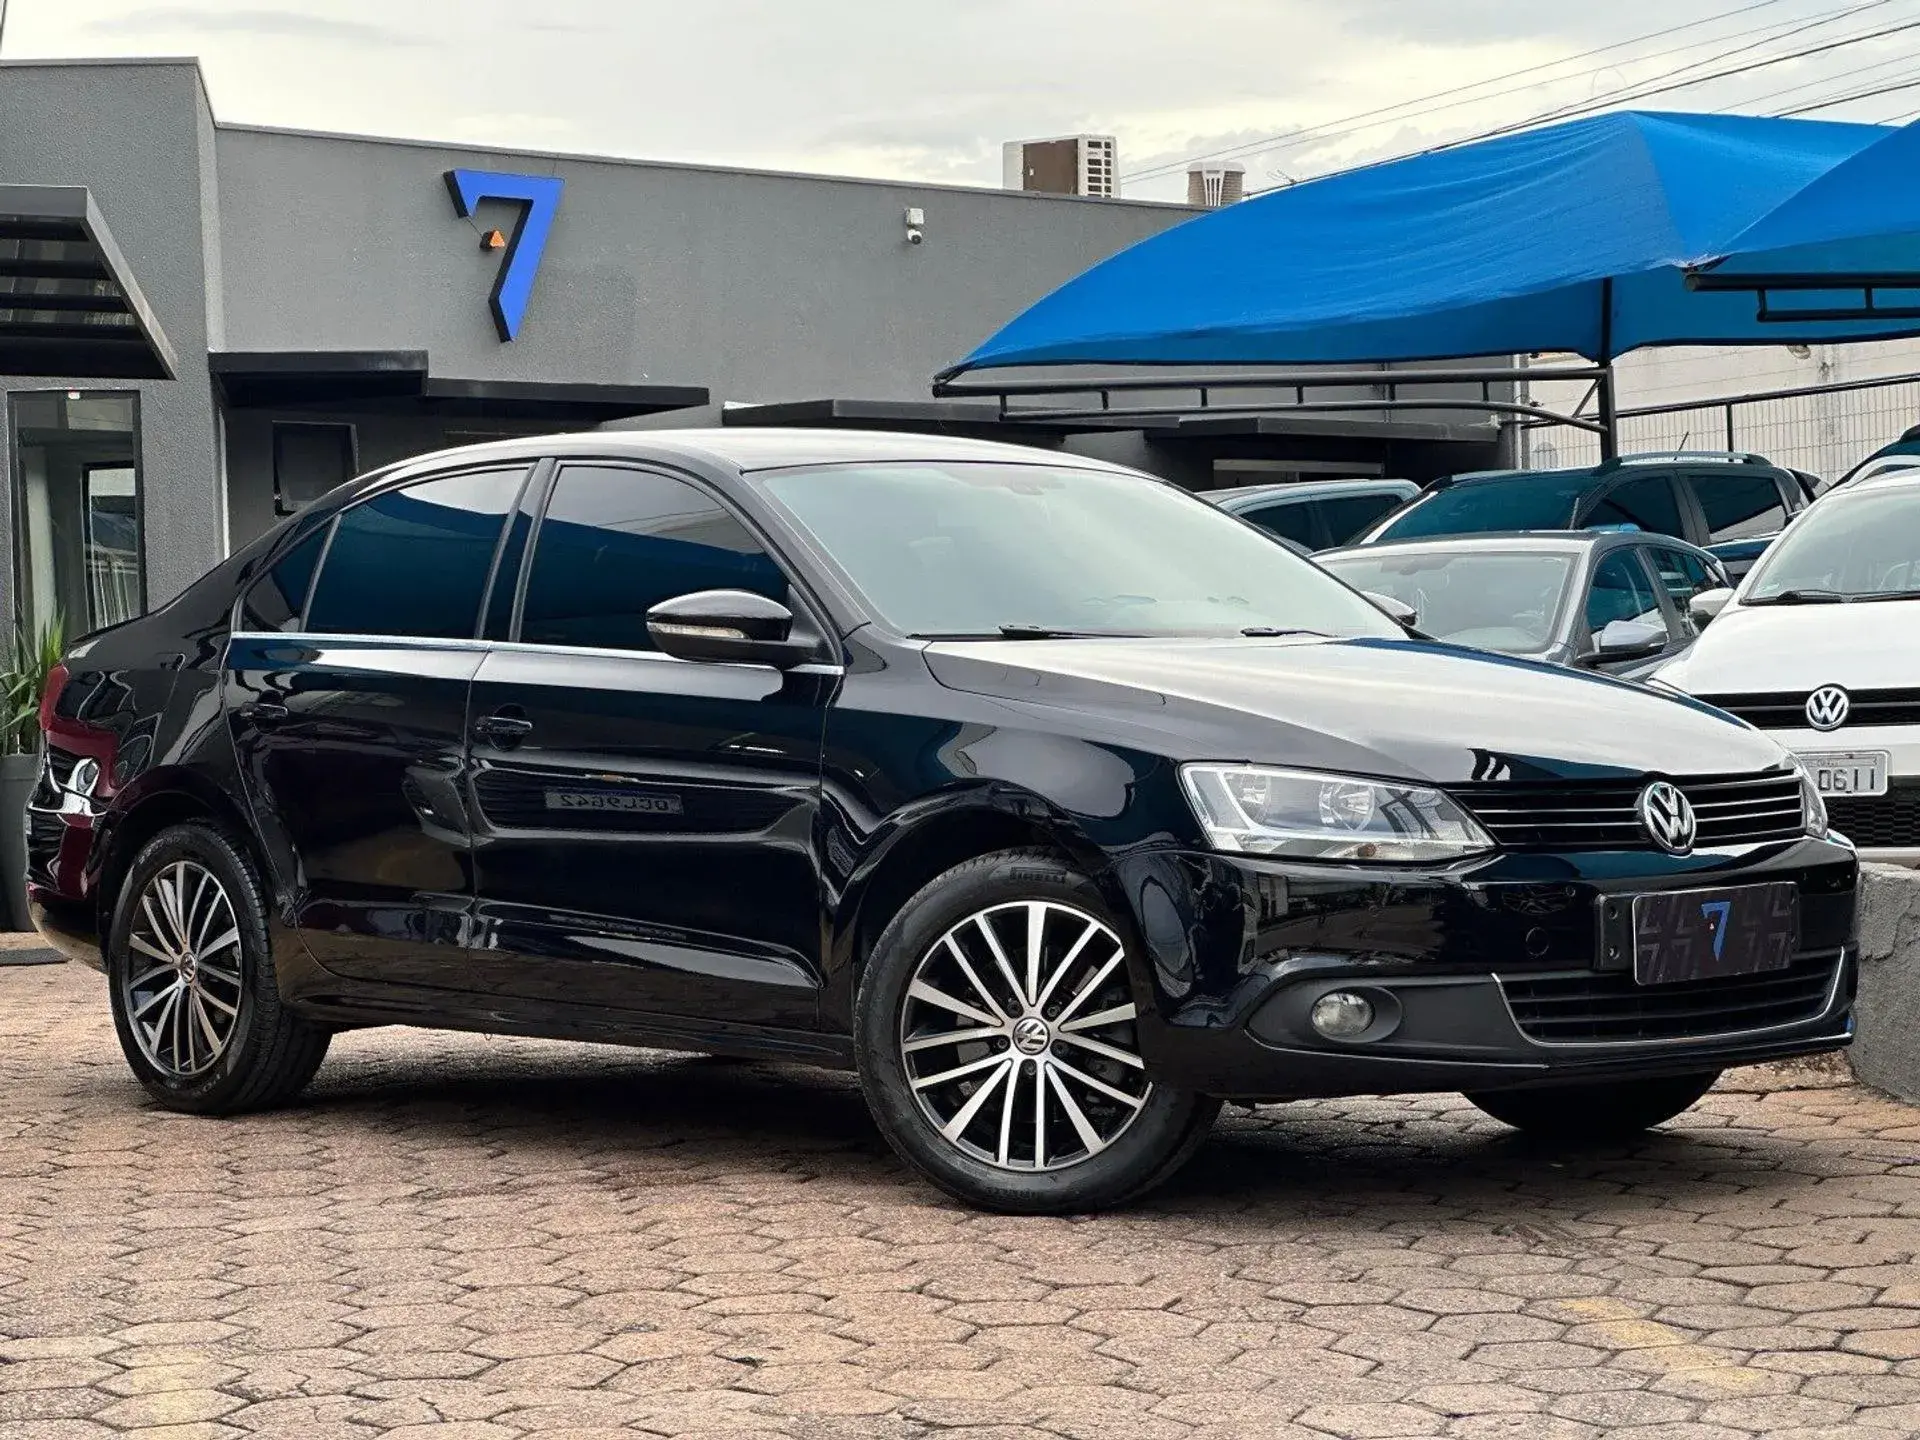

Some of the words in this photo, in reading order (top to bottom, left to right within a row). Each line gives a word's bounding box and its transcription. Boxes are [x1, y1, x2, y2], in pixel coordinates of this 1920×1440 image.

[444, 169, 565, 342] 7
[1806, 686, 1850, 729] VW
[1643, 782, 1696, 850] VW
